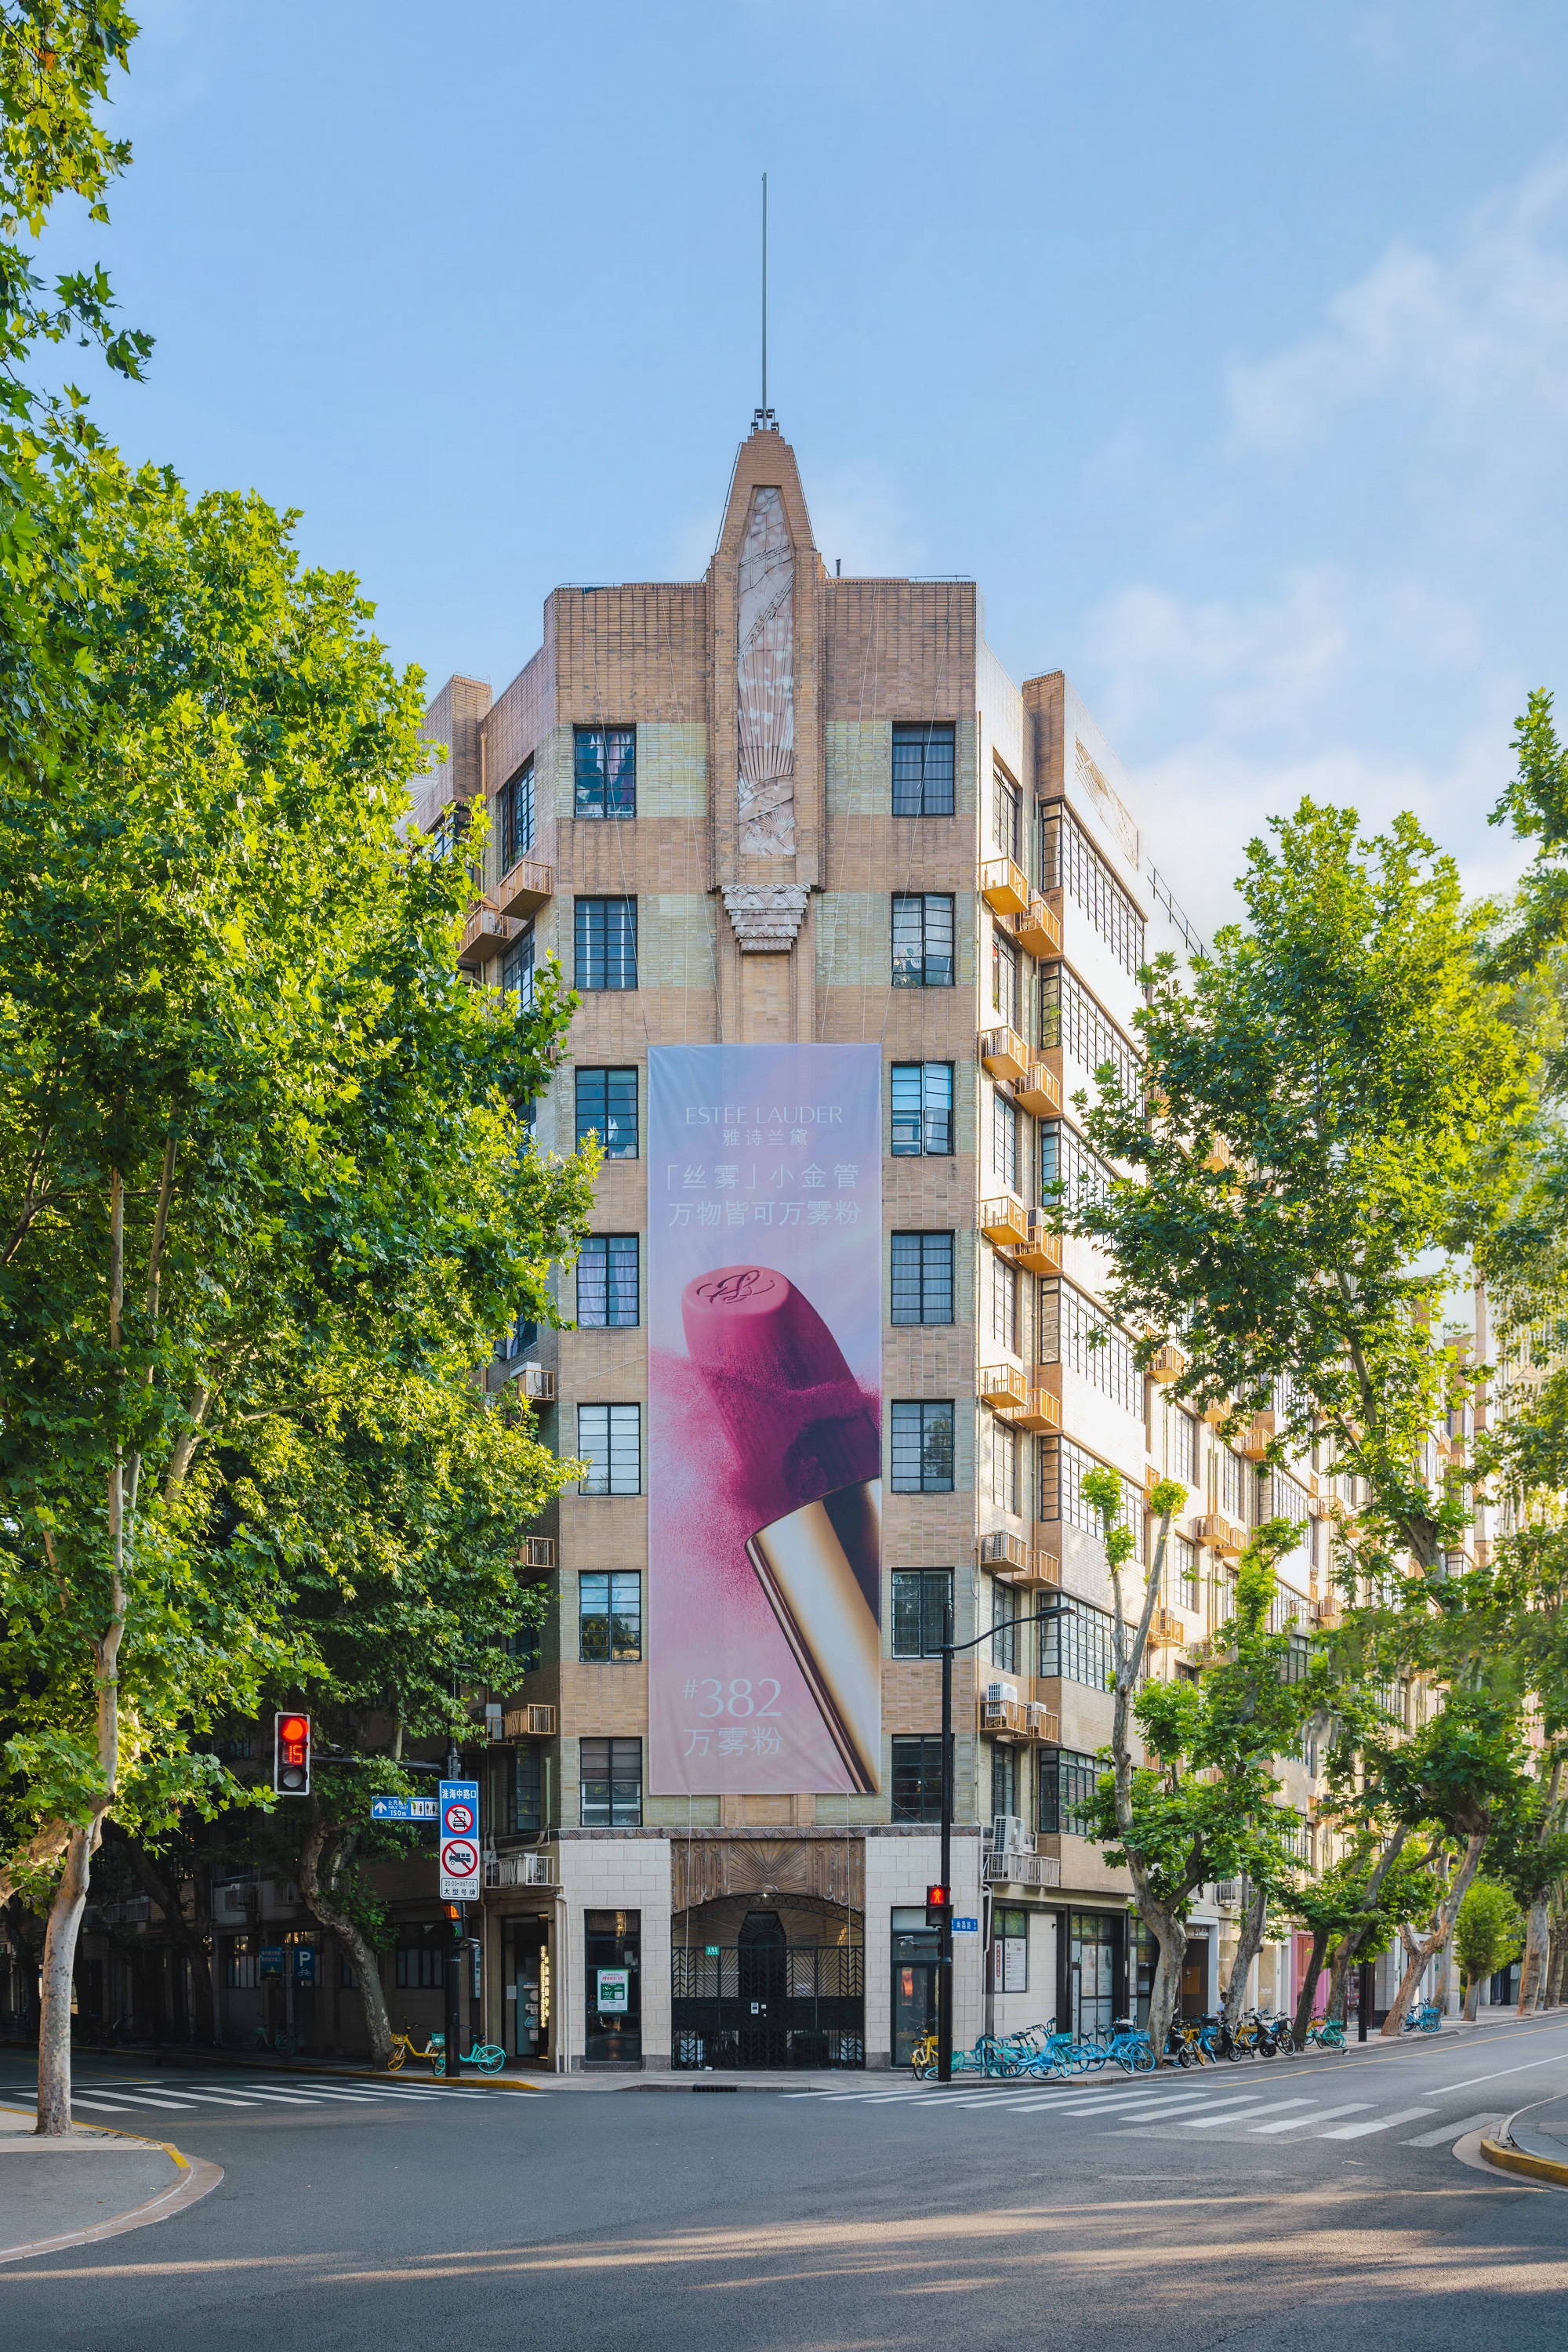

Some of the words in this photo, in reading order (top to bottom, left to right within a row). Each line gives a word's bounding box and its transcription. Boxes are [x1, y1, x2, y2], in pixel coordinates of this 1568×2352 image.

[756, 1105, 843, 1124] LAUDER
[722, 1128, 808, 1147] 雅诗兰黛
[668, 1200, 861, 1227] 万物皆可万雾粉
[682, 1678, 782, 1719] #382
[683, 1726, 782, 1757] 万雾粉
[289, 1744, 303, 1763] 15
[441, 1788, 477, 1800] 淮海中路口
[444, 1888, 476, 1896] 大型号牌
[956, 1921, 971, 1929] 南昌路
[299, 1951, 311, 1967] P
